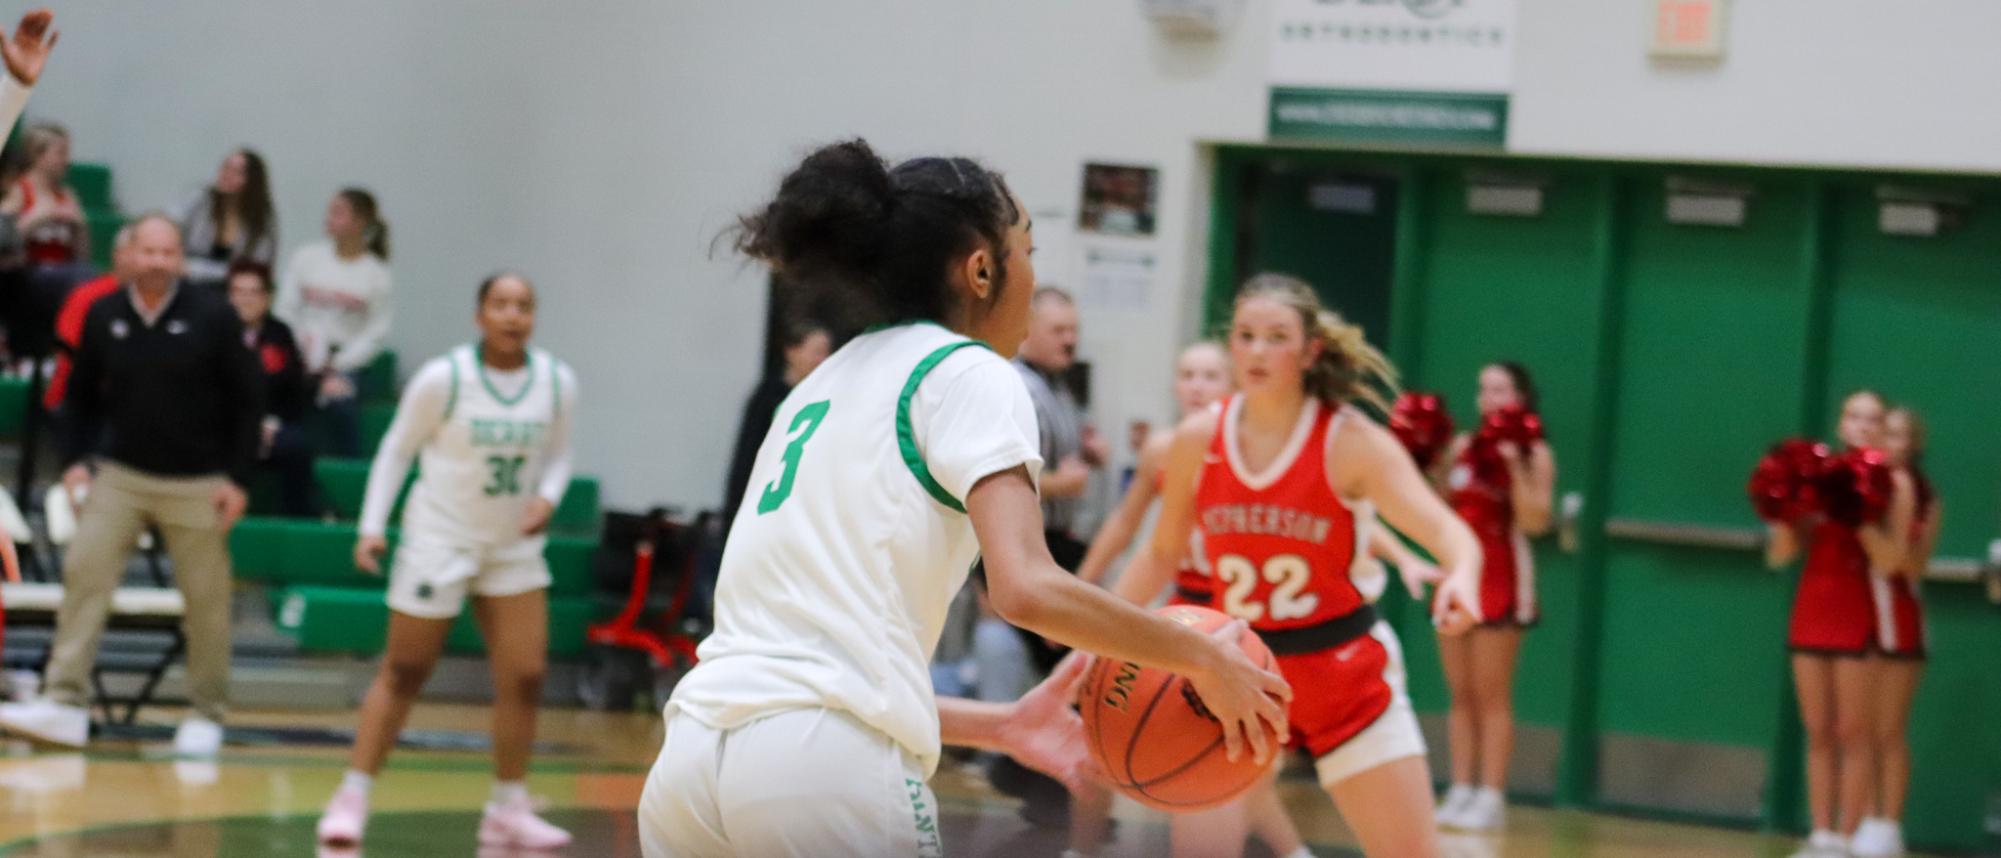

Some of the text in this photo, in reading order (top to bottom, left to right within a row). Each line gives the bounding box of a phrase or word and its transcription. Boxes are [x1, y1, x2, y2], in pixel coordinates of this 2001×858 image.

[757, 399, 830, 516] 3
[1217, 554, 1320, 622] 22
[1104, 661, 1140, 713] ING
